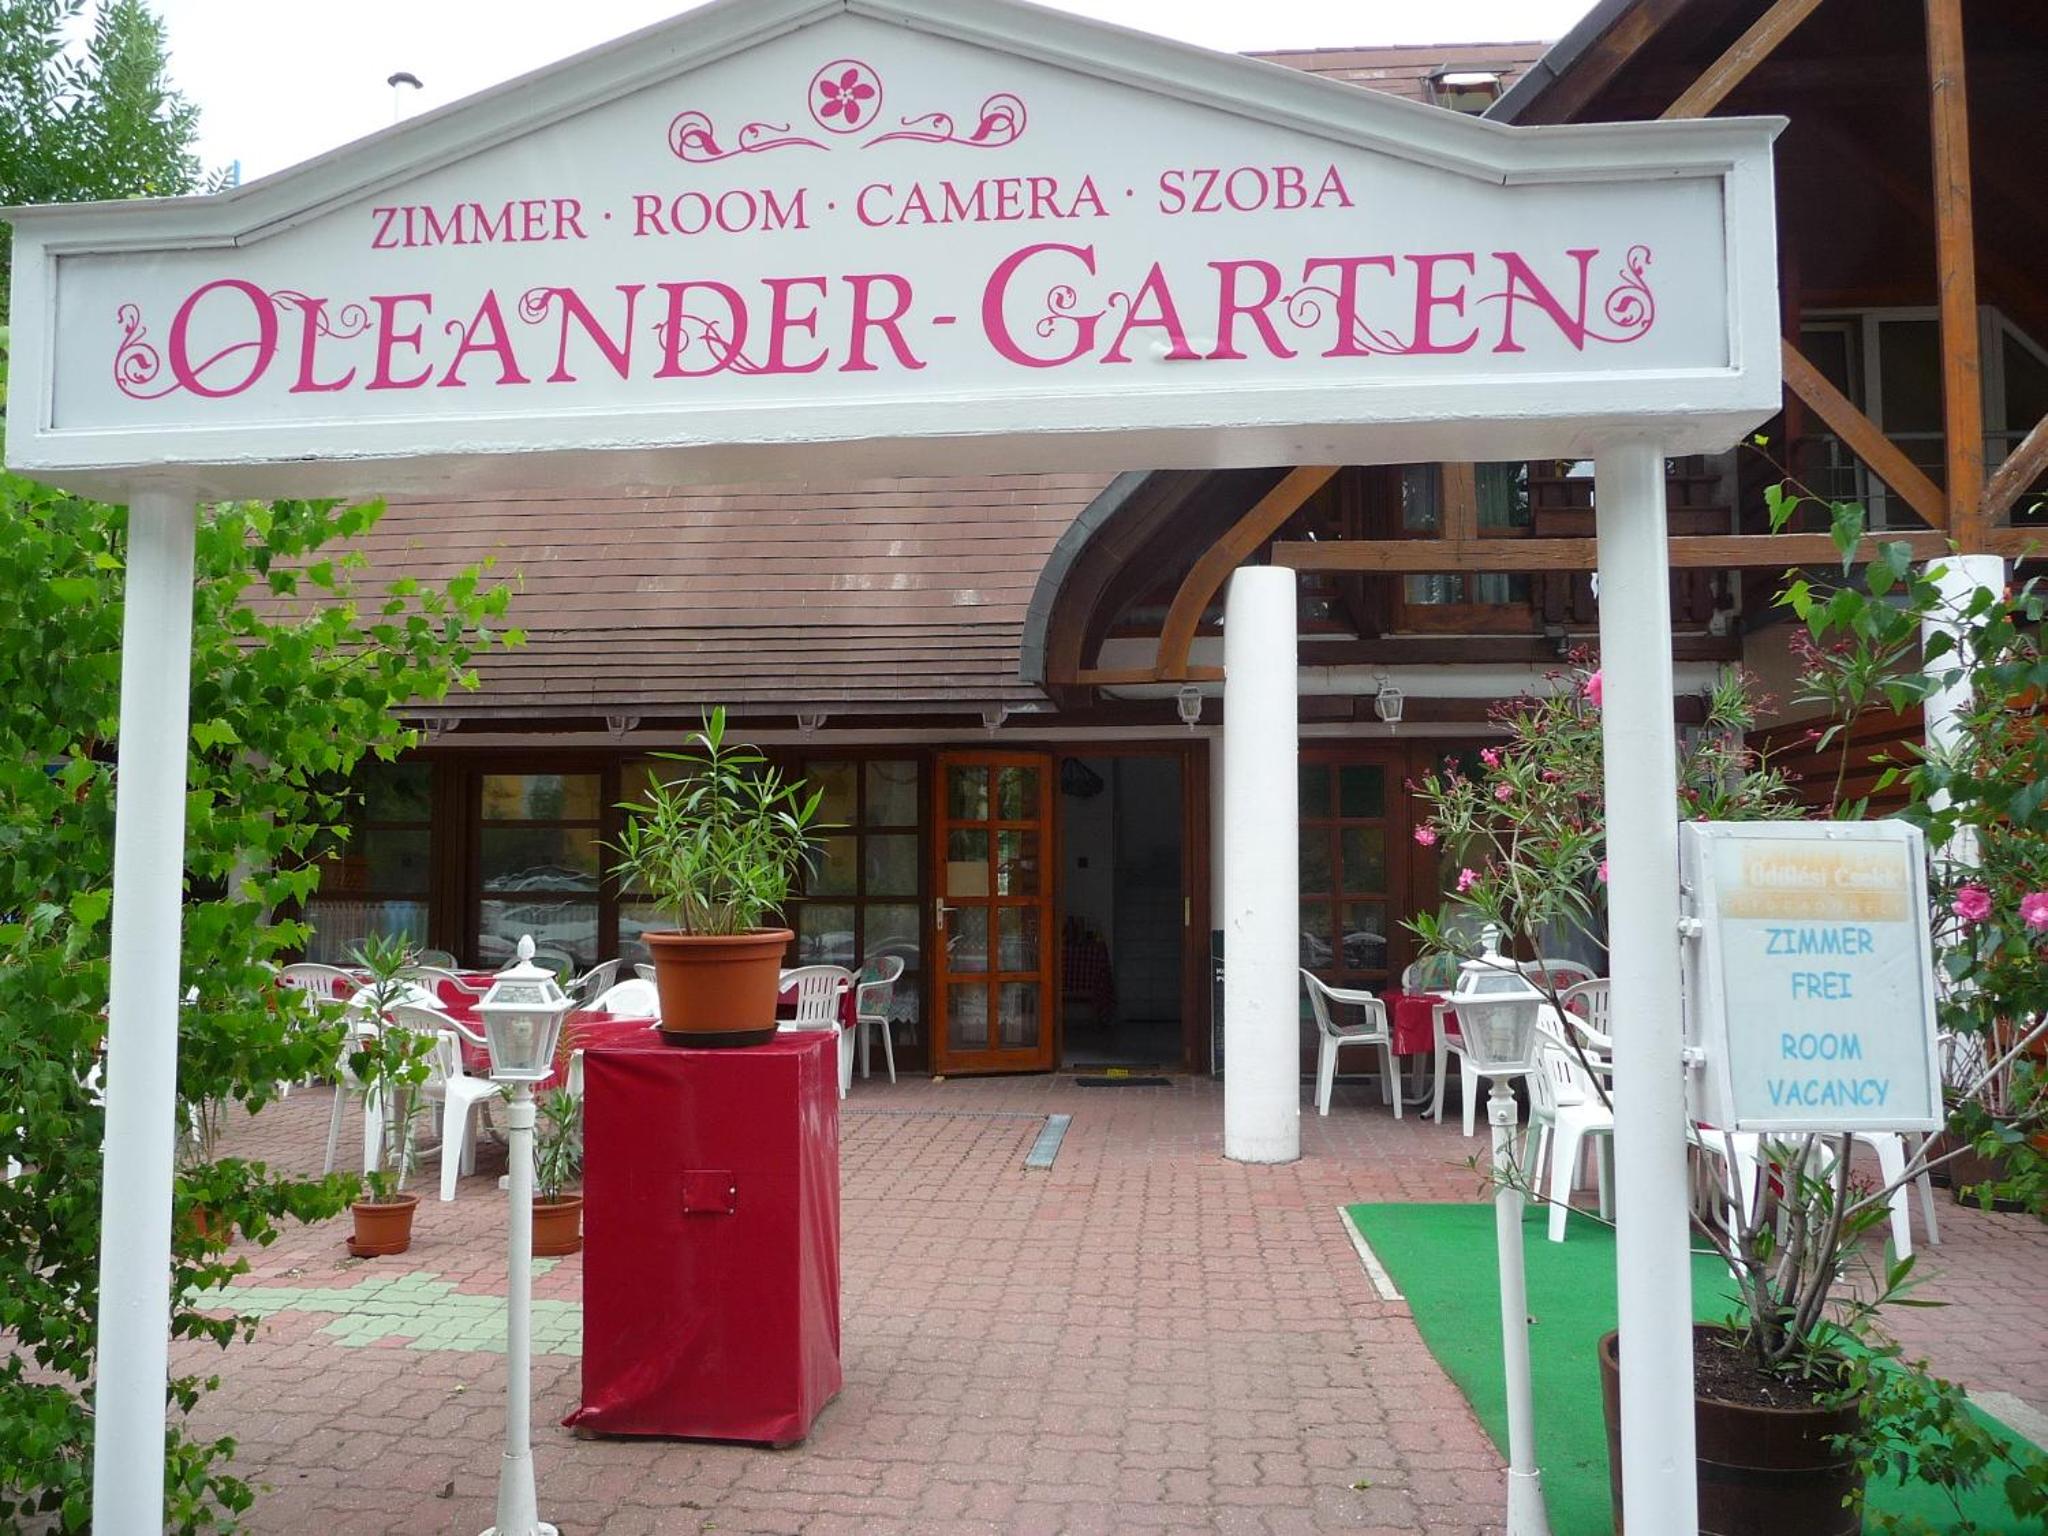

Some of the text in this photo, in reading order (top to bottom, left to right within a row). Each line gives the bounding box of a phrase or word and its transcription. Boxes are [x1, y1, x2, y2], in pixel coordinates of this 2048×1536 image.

[372, 165, 1352, 249] ZIMMER ROOM CAMERA SZOBA
[1766, 926, 1873, 956] ZIMMER
[1791, 971, 1853, 1000] FREI
[1780, 1033, 1862, 1062] ROOM
[1767, 1078, 1890, 1107] VACANCY
